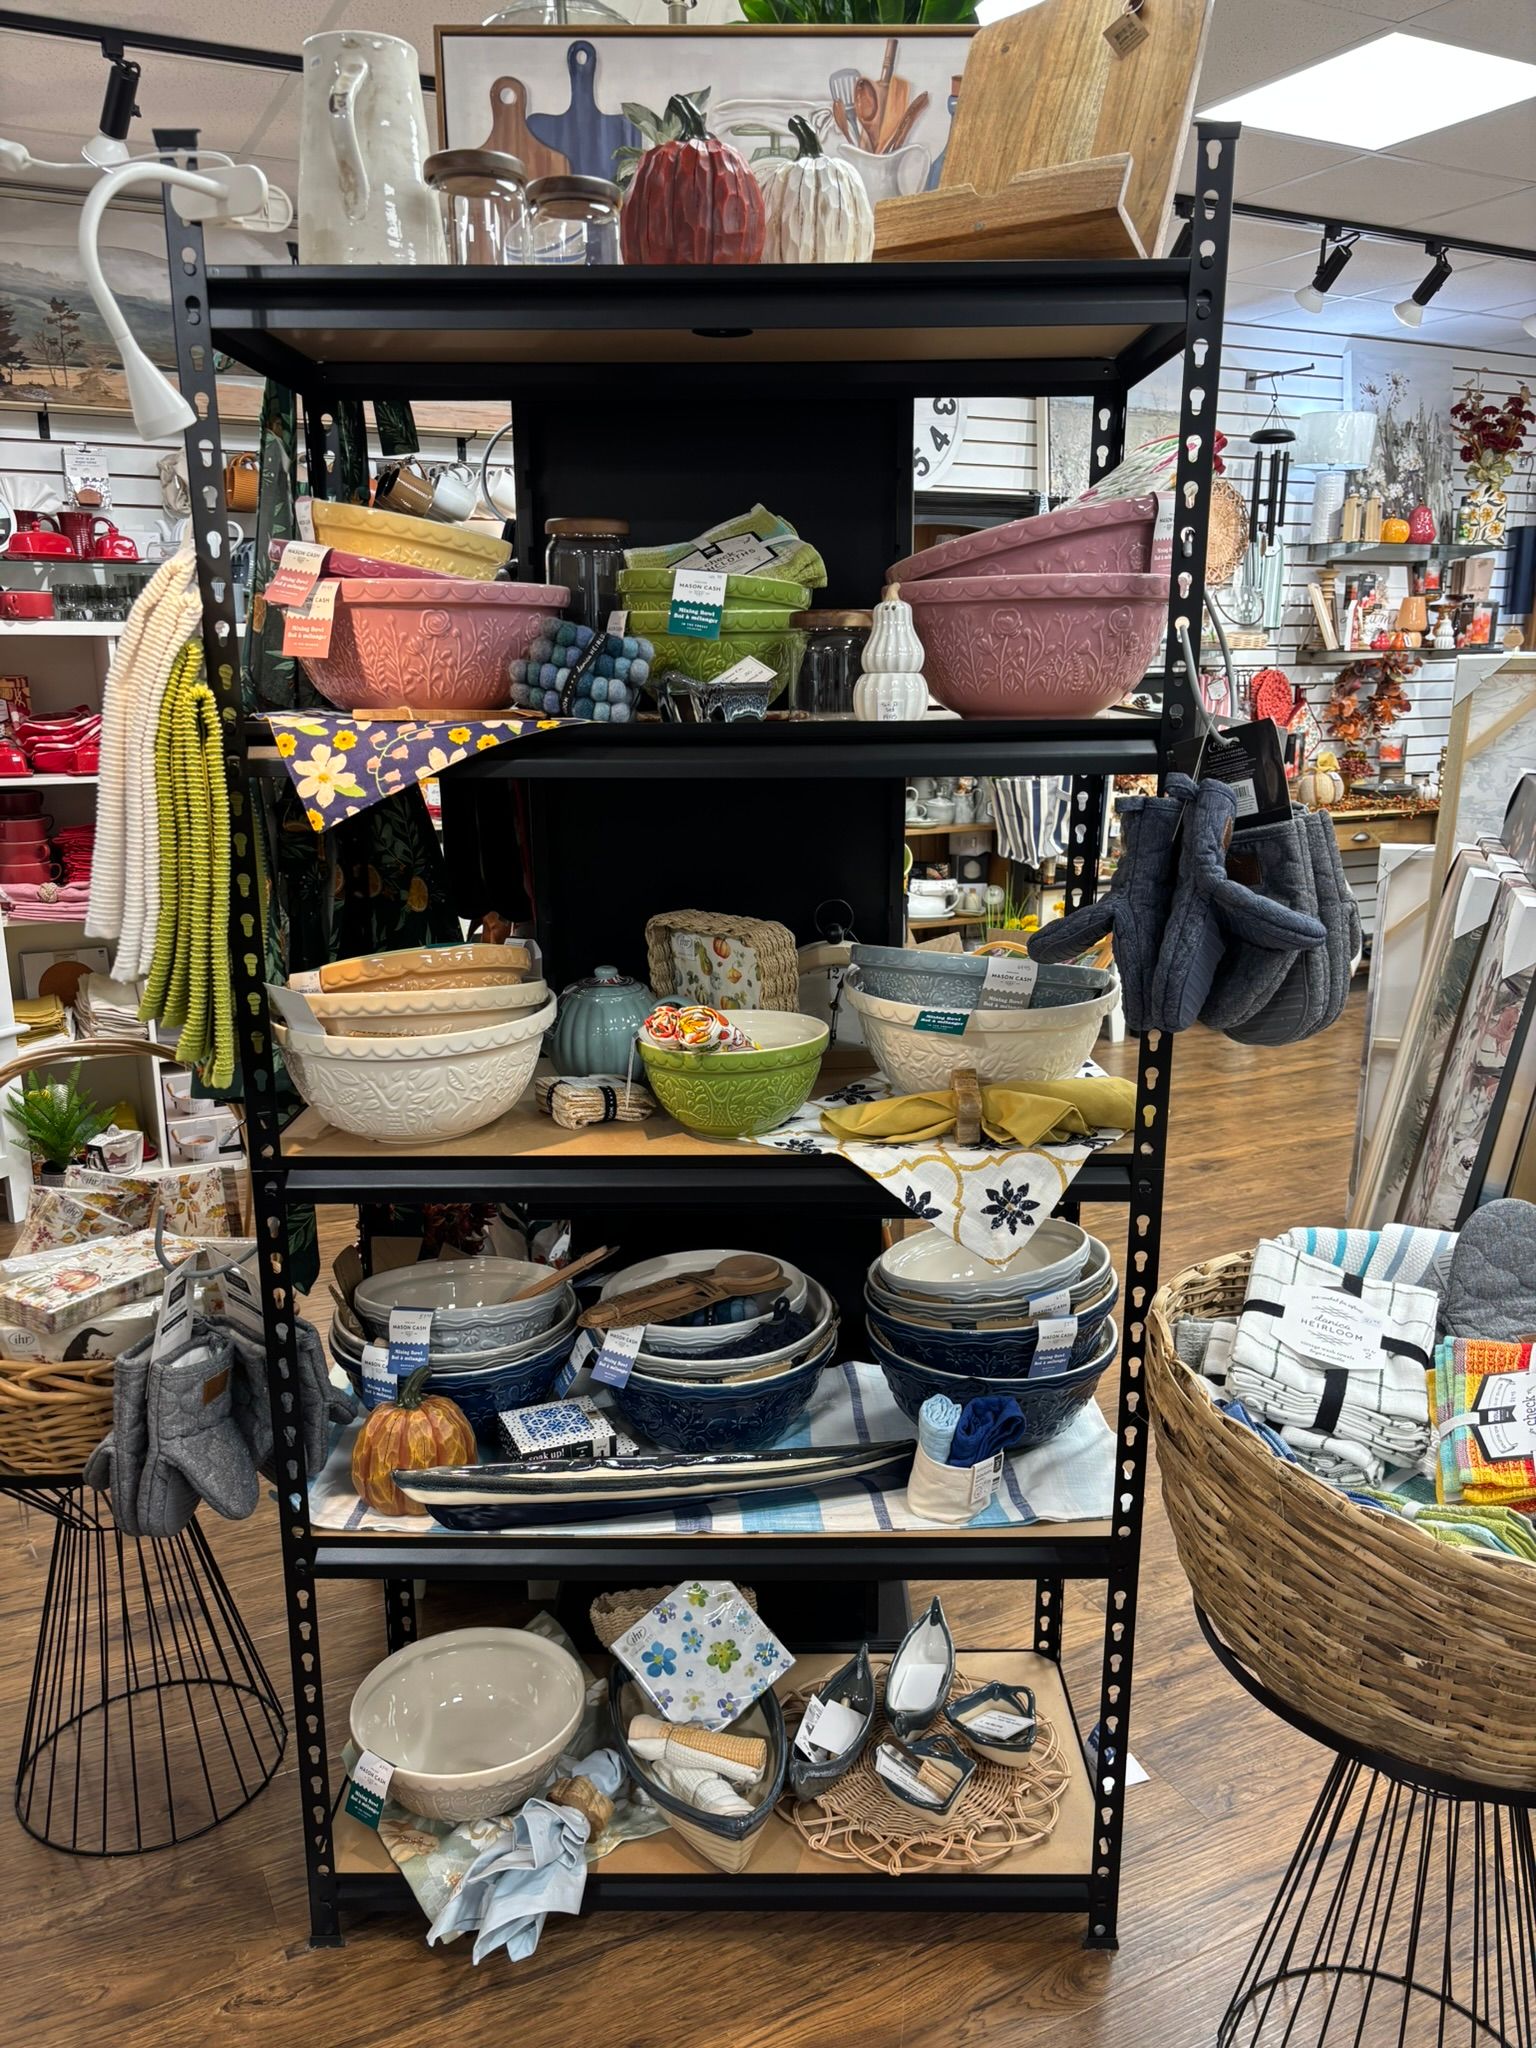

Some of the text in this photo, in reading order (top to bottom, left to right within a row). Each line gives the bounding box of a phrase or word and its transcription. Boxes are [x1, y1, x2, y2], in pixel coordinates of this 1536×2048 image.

[933, 398, 956, 416] 3
[930, 425, 950, 452] 4
[913, 447, 930, 476] 5
[288, 548, 320, 559] MASON CASH
[679, 607, 699, 615] Mixing
[827, 966, 840, 980] 12
[85, 1175, 98, 1185] ihr
[70, 1204, 80, 1216] ihr
[1314, 1314, 1351, 1330] danica
[1300, 1317, 1363, 1342] HEIRLOOM
[15, 1333, 31, 1344] ihr
[610, 1333, 626, 1341] MASON
[1522, 1395, 1536, 1426] check
[550, 1448, 565, 1459] up!
[631, 1629, 643, 1644] ihr
[360, 1766, 386, 1785] MASON CASH
